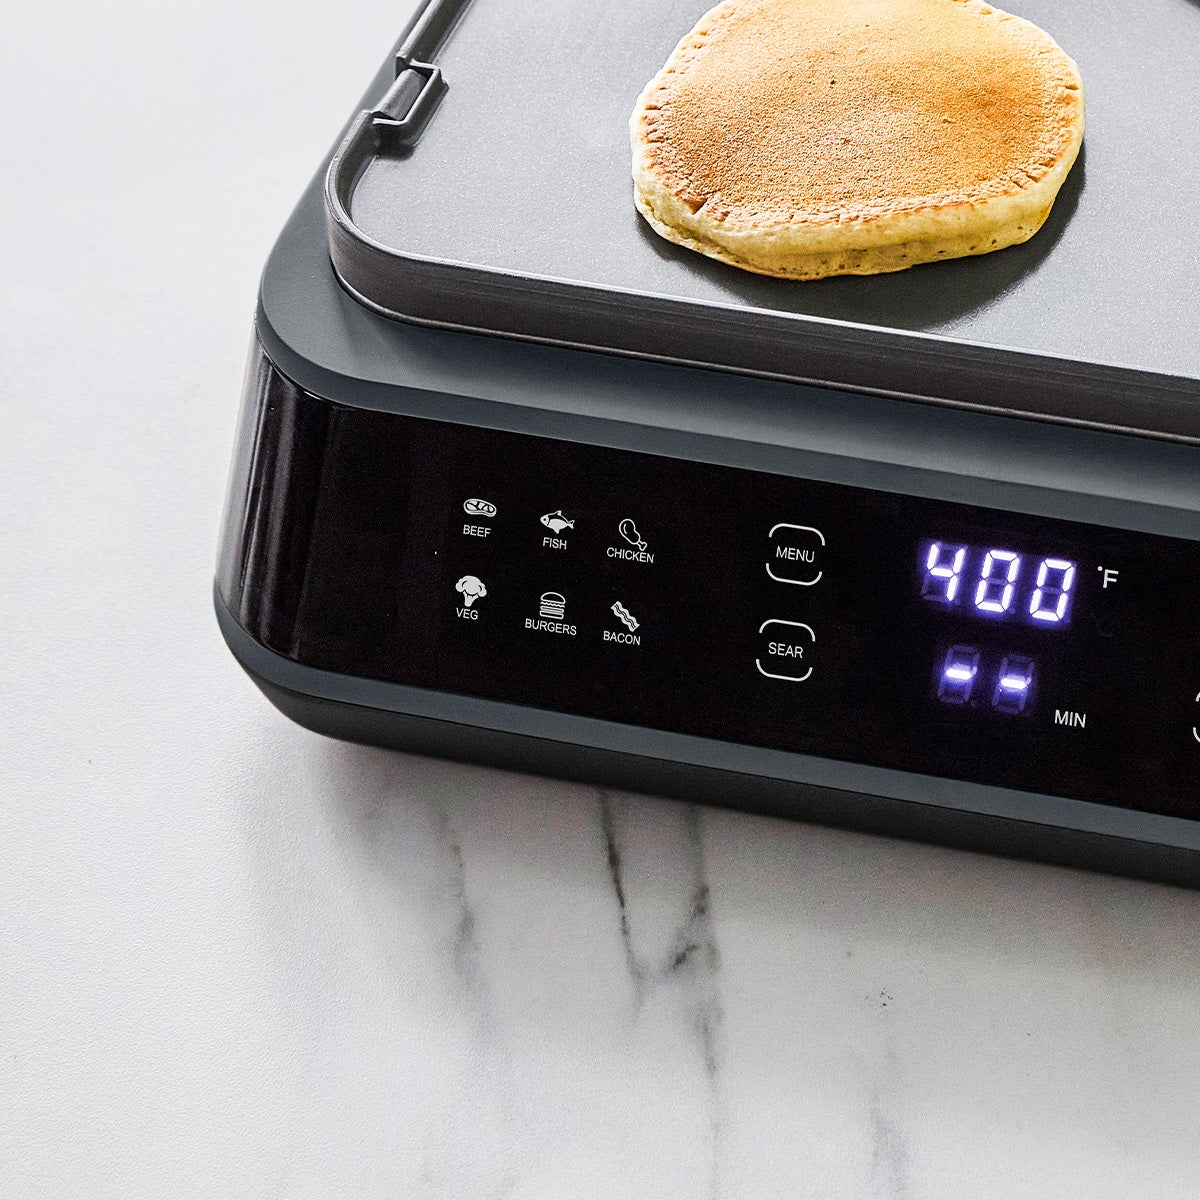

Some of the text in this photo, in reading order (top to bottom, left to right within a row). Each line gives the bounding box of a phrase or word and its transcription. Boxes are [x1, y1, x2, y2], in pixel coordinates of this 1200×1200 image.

[462, 524, 492, 538] BEEF
[542, 536, 568, 550] FISH
[606, 547, 655, 564] CHICKEN
[775, 545, 815, 563] MENU
[926, 543, 1075, 622] 400
[456, 607, 479, 621] VEG
[524, 618, 577, 636] BURGERS
[603, 630, 641, 646] BACON
[768, 641, 804, 659] SEAR
[1054, 709, 1087, 729] MIN
